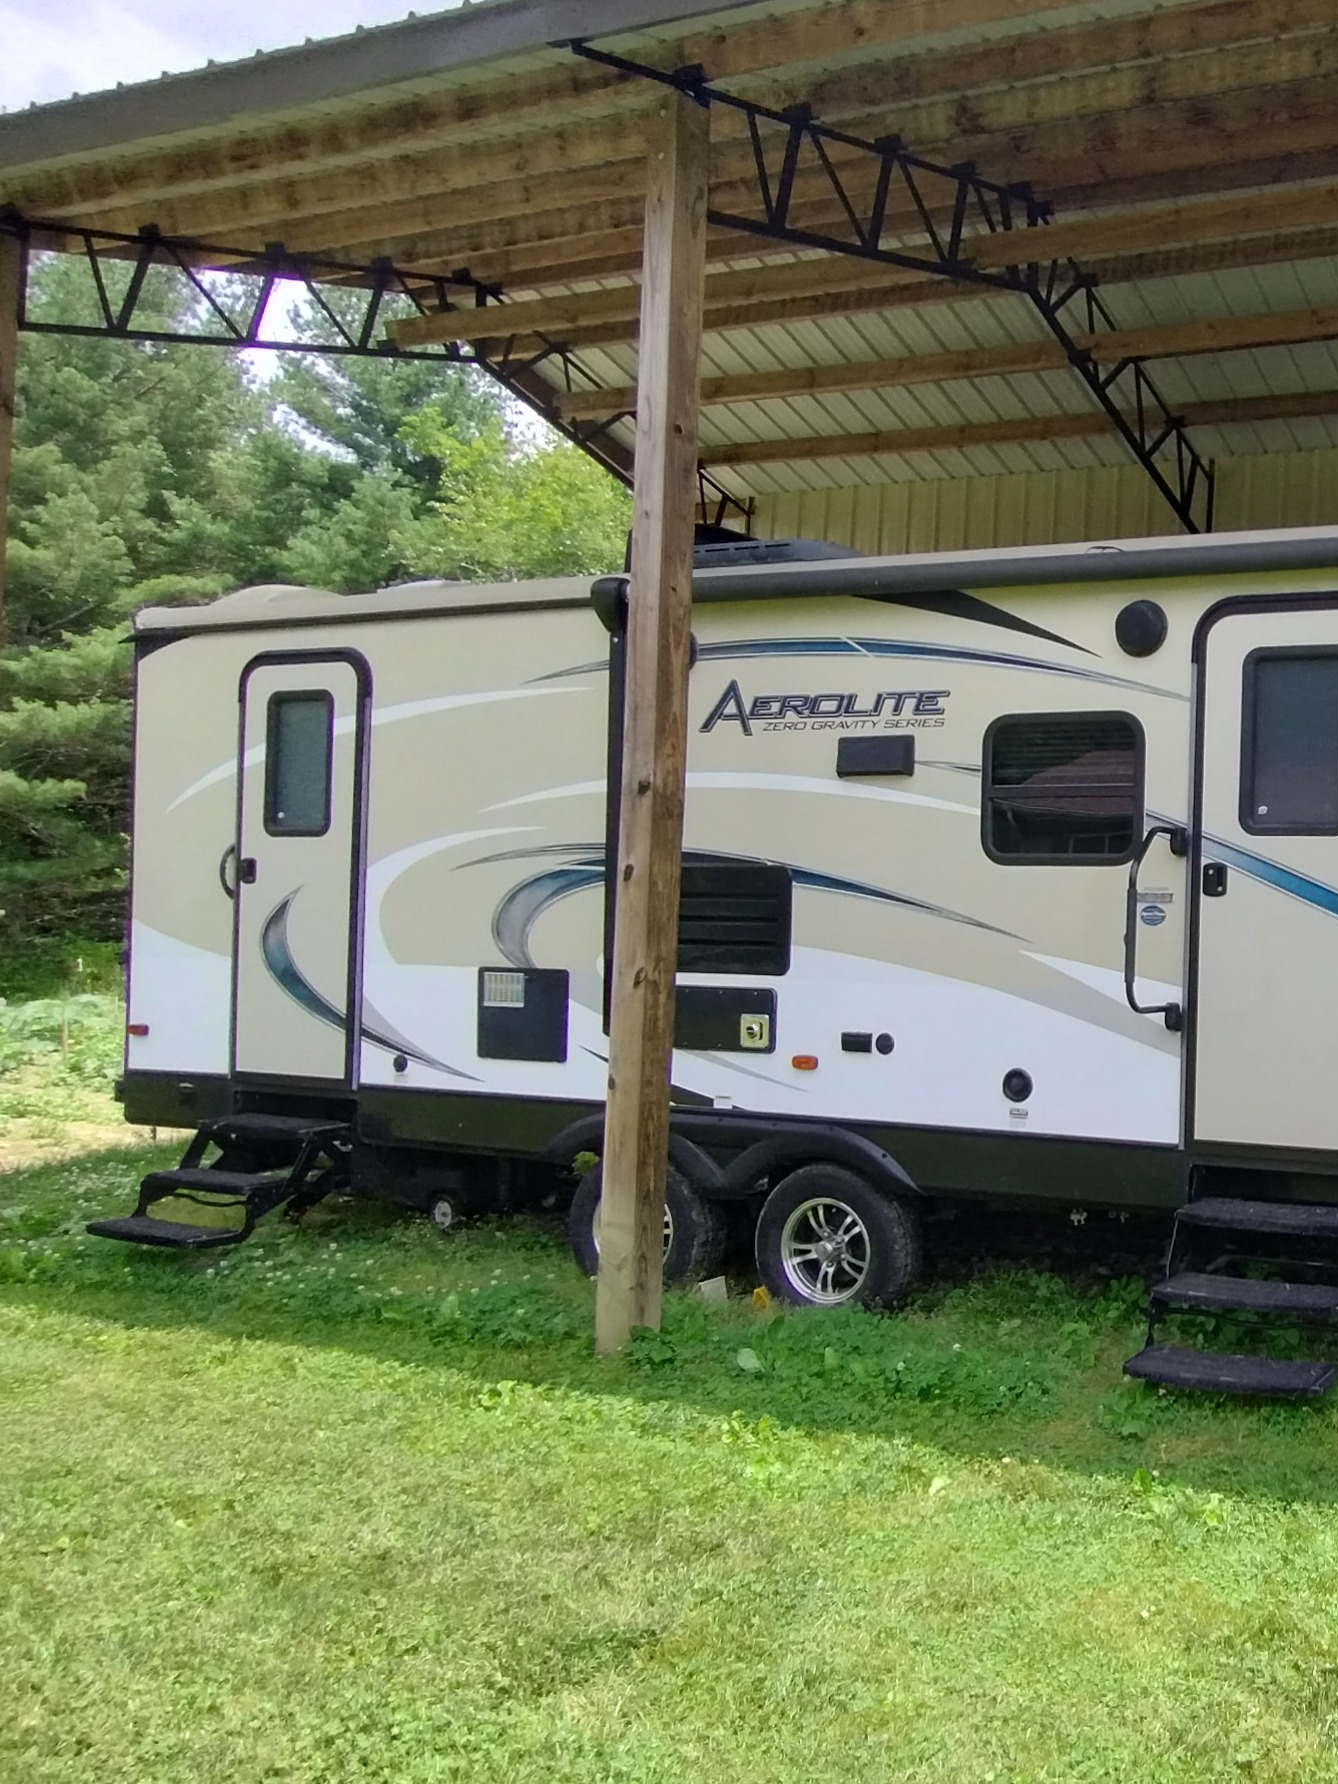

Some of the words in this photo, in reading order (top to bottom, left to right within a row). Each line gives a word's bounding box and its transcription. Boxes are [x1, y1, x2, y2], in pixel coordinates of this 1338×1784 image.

[699, 679, 951, 736] AEROLITE
[762, 721, 807, 732] ZERO
[811, 719, 880, 731] GRAVITY
[883, 717, 946, 729] SERIES
